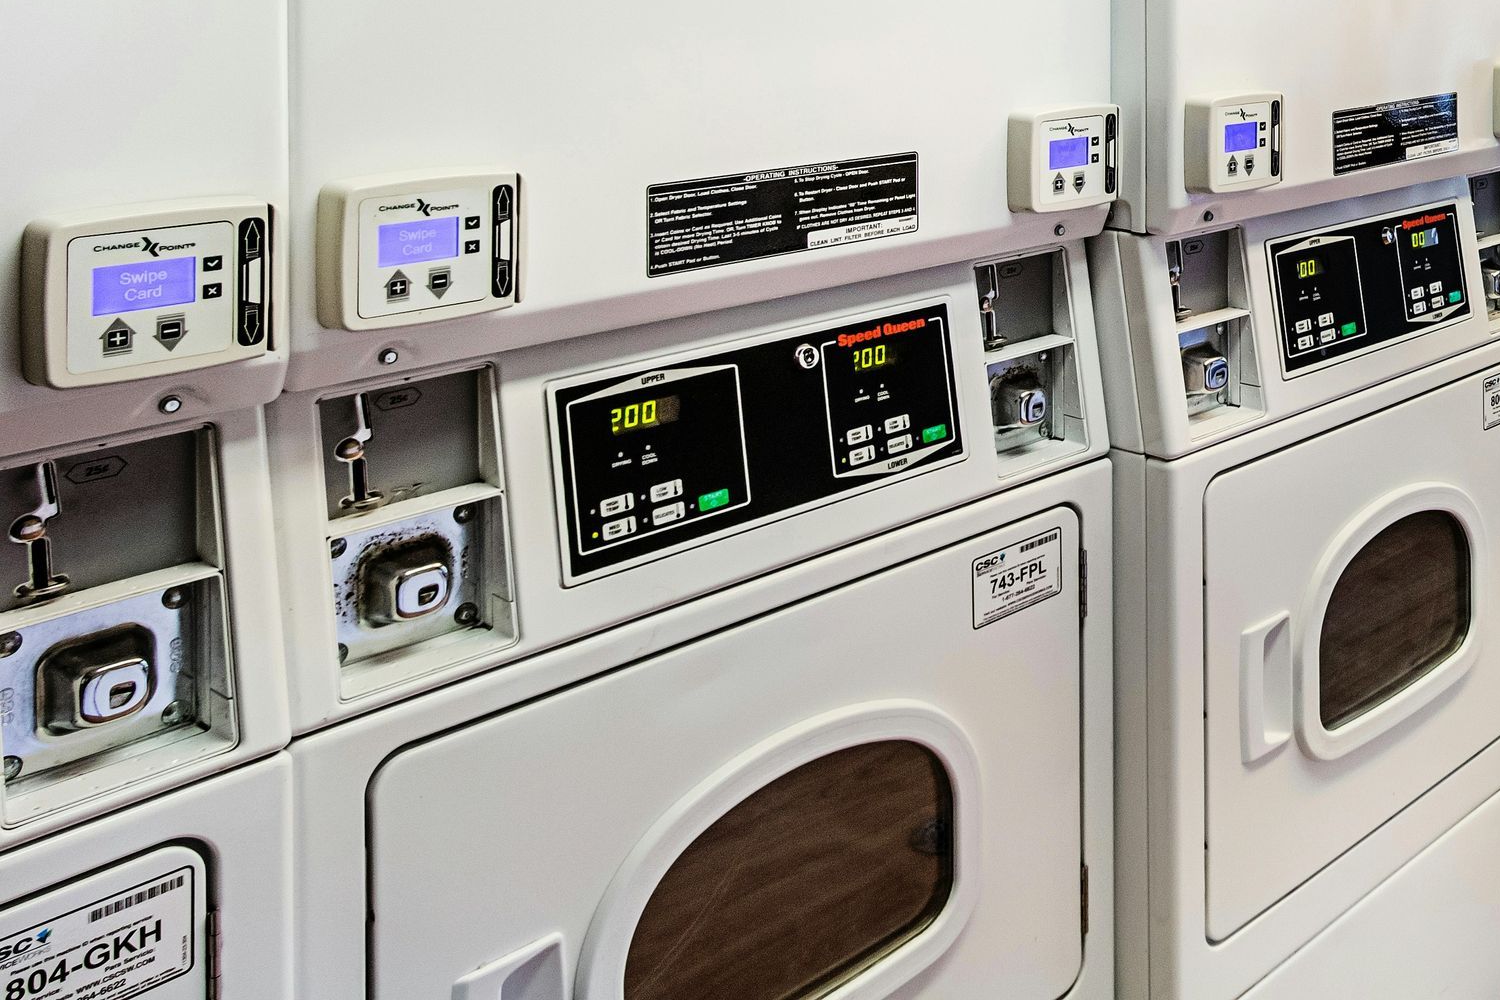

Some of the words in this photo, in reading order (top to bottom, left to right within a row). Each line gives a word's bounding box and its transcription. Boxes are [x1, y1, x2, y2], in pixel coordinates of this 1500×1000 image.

[399, 228, 437, 242] Swipe
[93, 241, 140, 253] CHANGE
[402, 241, 433, 255] Card
[119, 269, 168, 286] Swipe
[1297, 260, 1315, 279] 00
[124, 285, 163, 301] Card
[837, 325, 882, 348] Speed
[883, 318, 926, 335] Queen
[641, 373, 666, 385] UPPER
[887, 458, 908, 470] LOWER
[975, 556, 999, 572] CSC
[990, 560, 1047, 595] 743-FPL
[6, 918, 162, 1000] 804-GKH
